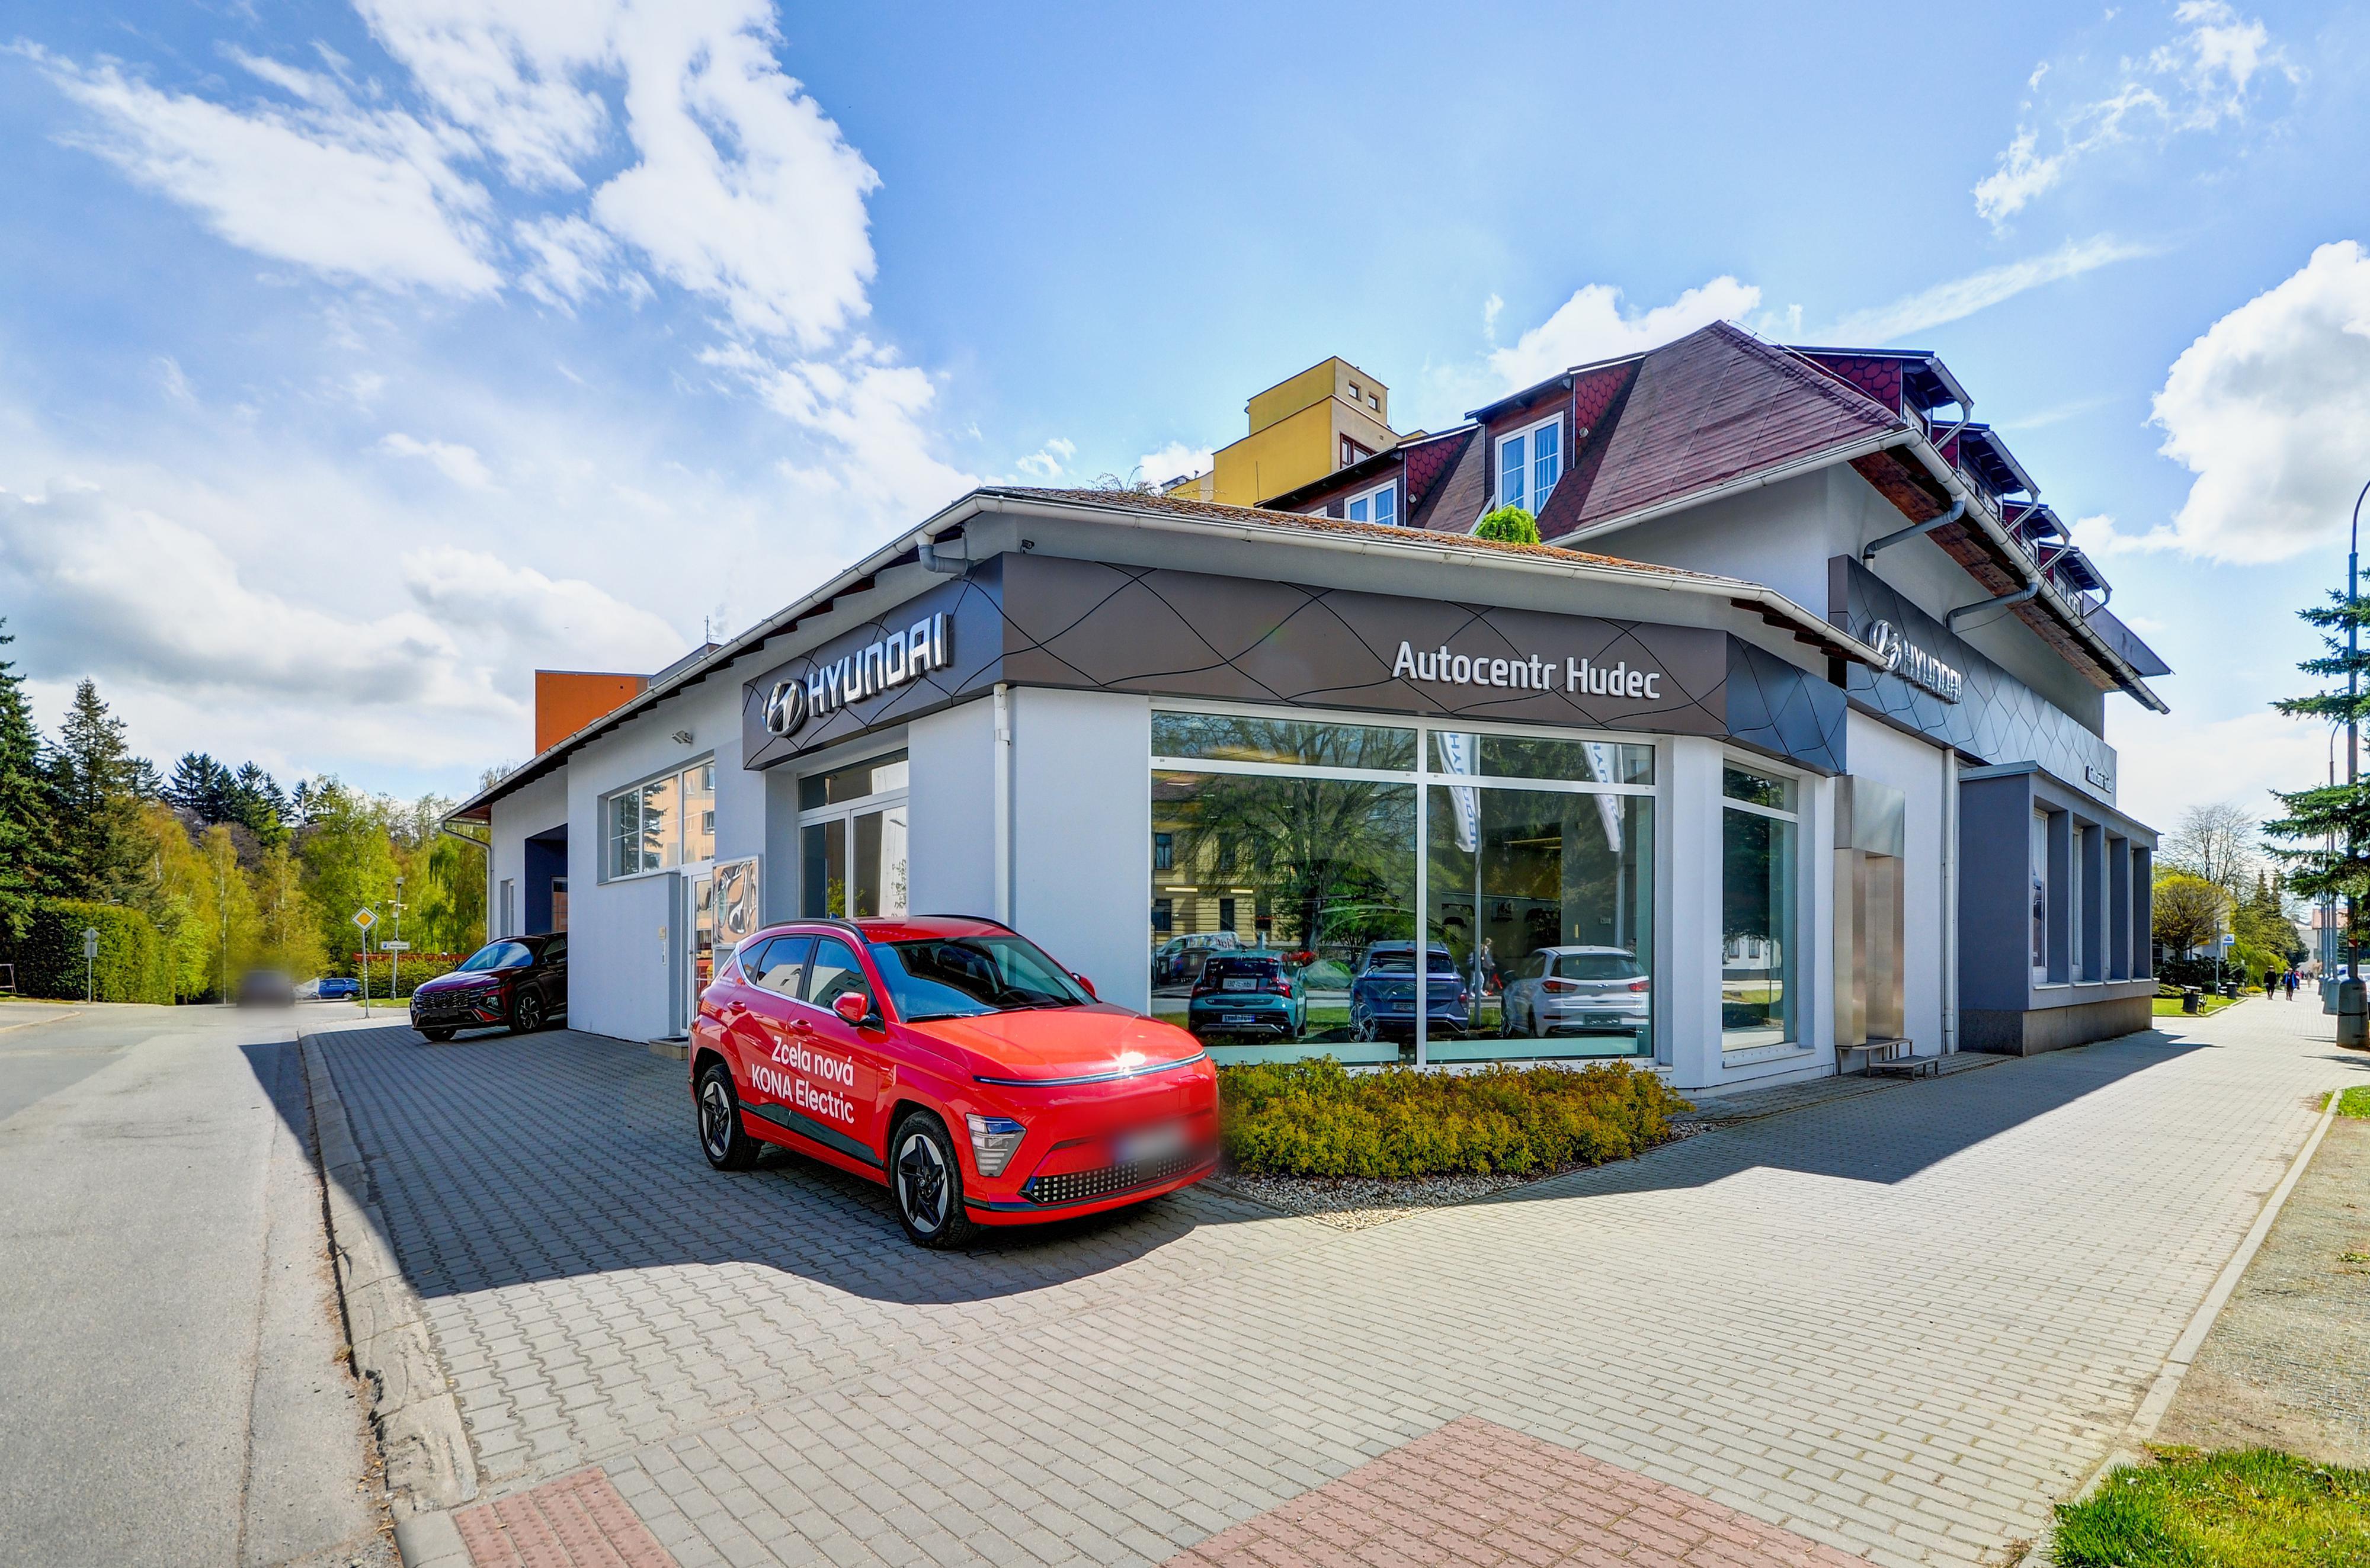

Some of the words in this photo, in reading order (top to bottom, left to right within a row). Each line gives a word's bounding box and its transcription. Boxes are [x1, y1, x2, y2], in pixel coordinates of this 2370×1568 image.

[806, 611, 948, 717] HYUNDAI
[1392, 640, 1556, 691] Autocentr
[1566, 656, 1660, 700] Hudec
[1899, 639, 1962, 704] HYUNDAI
[771, 1035, 811, 1073] Zcela
[814, 1056, 854, 1086] nová
[752, 1064, 793, 1102] KONA
[796, 1079, 854, 1124] Electric
